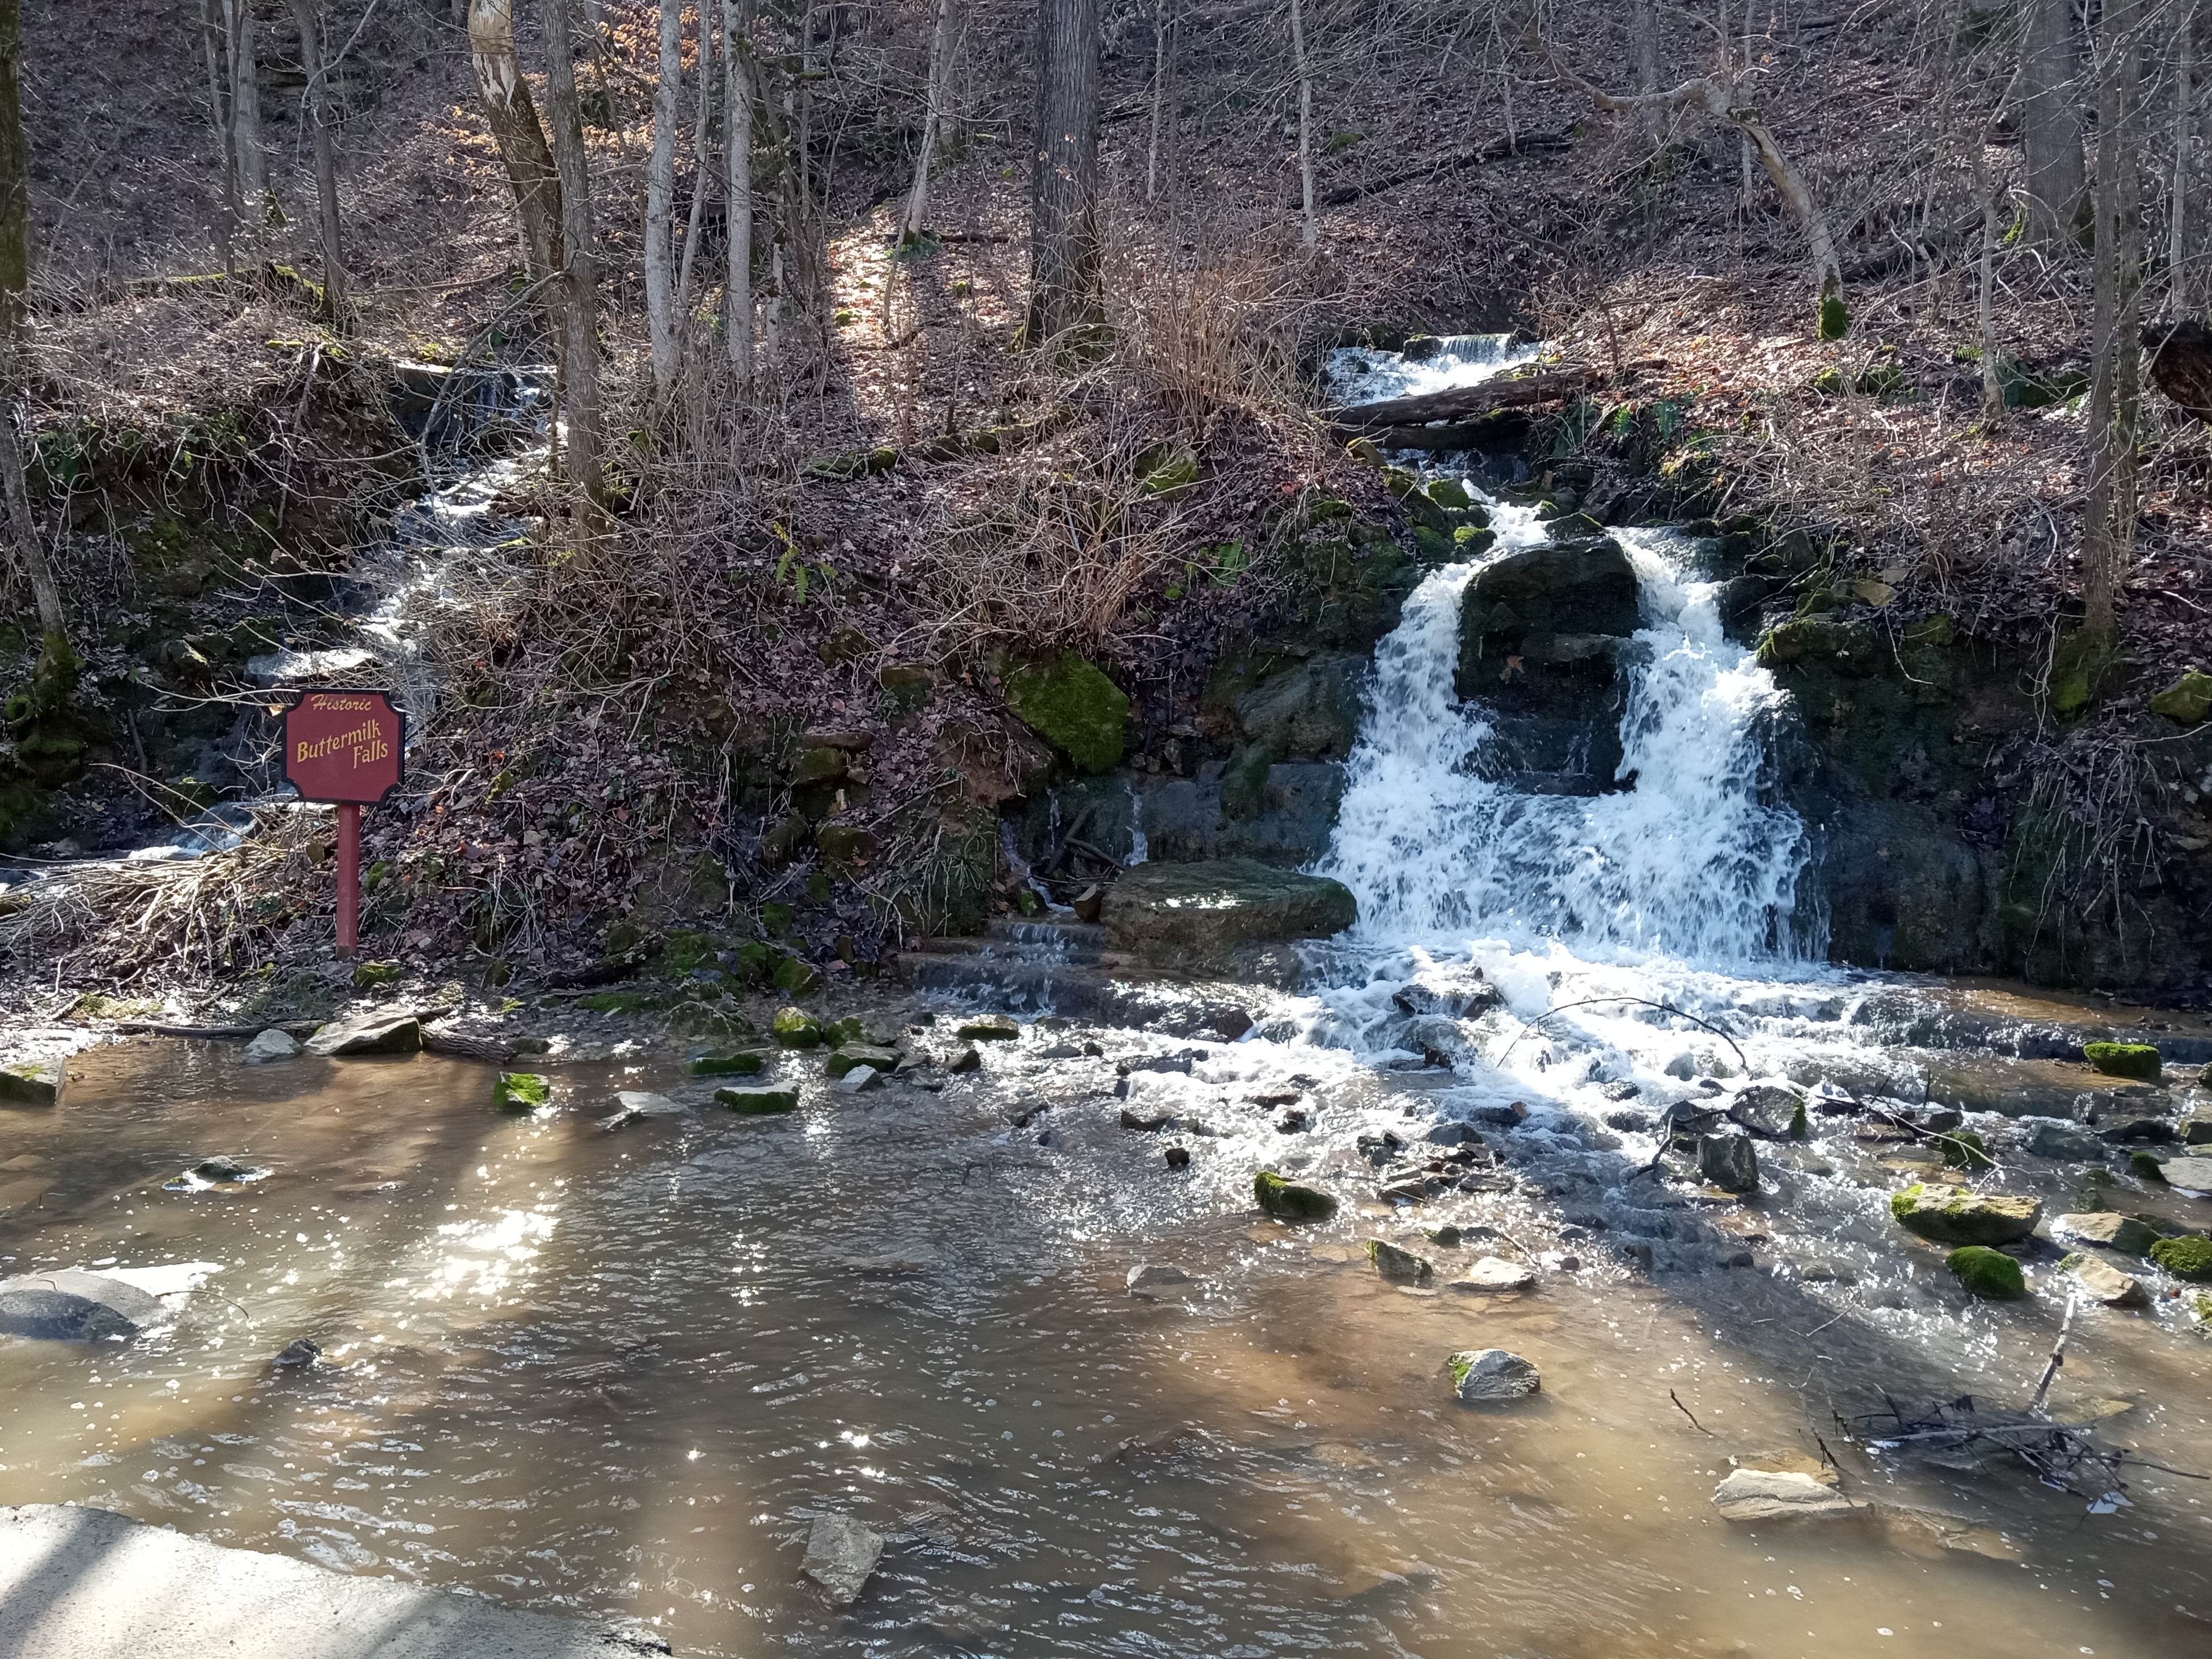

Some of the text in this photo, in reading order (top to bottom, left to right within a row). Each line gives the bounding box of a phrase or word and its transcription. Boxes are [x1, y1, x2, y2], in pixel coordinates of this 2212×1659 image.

[311, 694, 372, 711] Historic
[297, 719, 381, 763] Buttermilk
[353, 739, 388, 769] Falls
